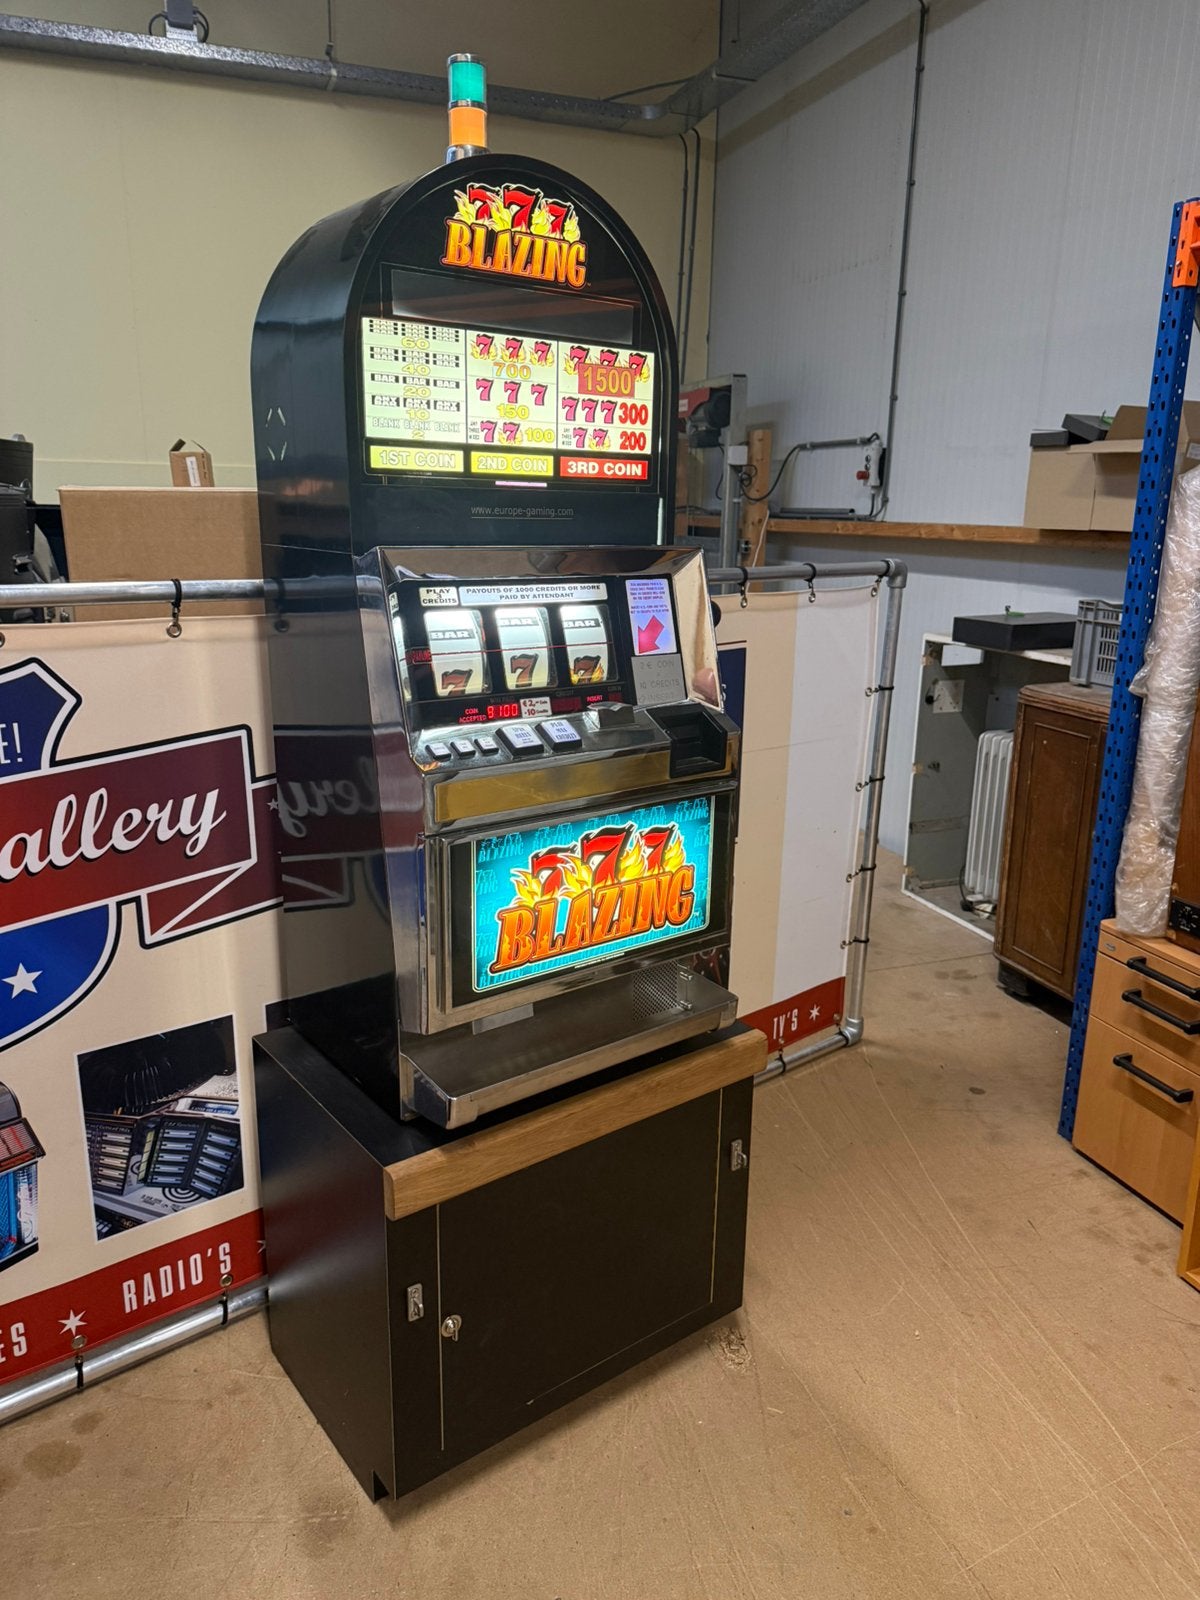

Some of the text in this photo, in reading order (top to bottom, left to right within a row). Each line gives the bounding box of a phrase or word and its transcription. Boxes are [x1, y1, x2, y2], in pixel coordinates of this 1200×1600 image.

[441, 217, 587, 289] BLAZING
[401, 336, 430, 350] 60
[402, 363, 431, 376] 40
[493, 362, 531, 379] 700
[374, 374, 457, 388] BAR BAR BAR
[583, 366, 632, 394] 1500
[403, 386, 431, 398] 20
[406, 408, 430, 420] 10
[496, 403, 529, 420] 150
[618, 402, 649, 425] 300
[372, 416, 400, 429] BLANK
[411, 429, 425, 440] 2
[525, 427, 555, 443] 100
[619, 431, 647, 451] 200
[379, 449, 456, 468] 1ST COIN
[477, 455, 549, 473] 2ND COIN
[567, 460, 643, 476] 3RD COIN
[471, 505, 574, 517] www.europe-gaming.com
[431, 617, 597, 640] BAR BAR BAR
[458, 714, 487, 723] ACCEPTED
[0, 787, 226, 880] allery
[490, 865, 695, 973] BLAZING
[773, 1008, 799, 1040] TV'S
[122, 1242, 232, 1314] RADIO'S
